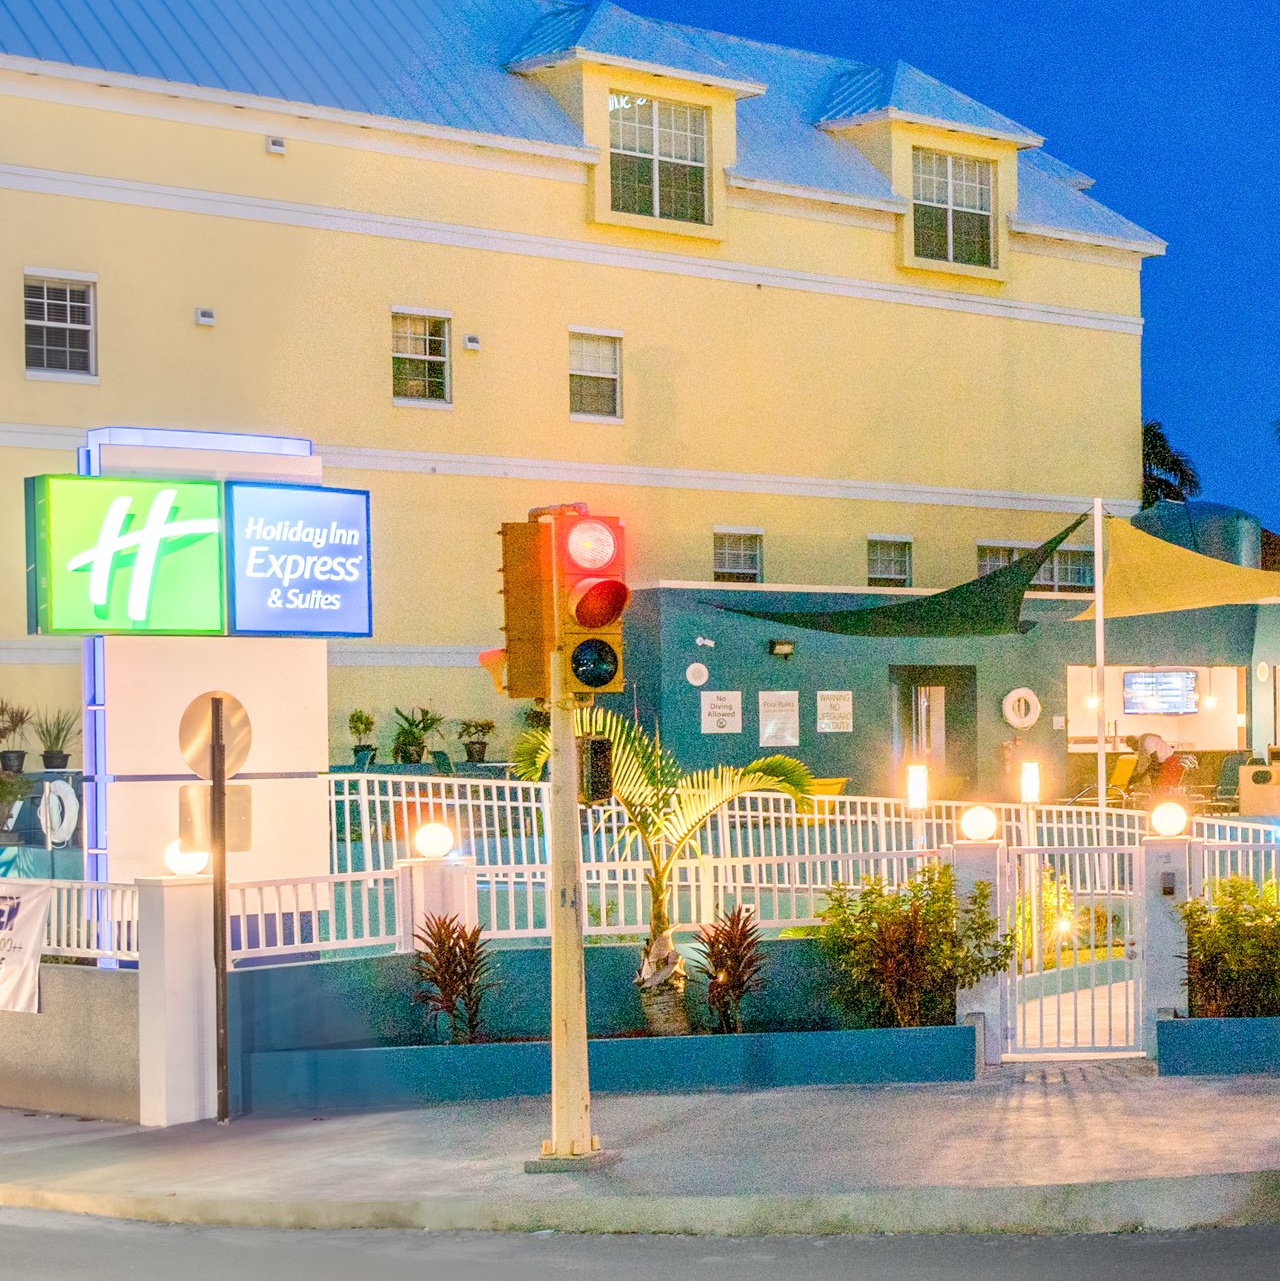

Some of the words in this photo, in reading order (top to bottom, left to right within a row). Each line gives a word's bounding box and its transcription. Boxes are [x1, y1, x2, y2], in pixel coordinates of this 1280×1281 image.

[244, 517, 328, 548] Holiday
[329, 521, 359, 546] Inn
[245, 546, 362, 586] Express
[267, 589, 282, 608] &
[286, 588, 341, 610] Suites
[820, 694, 850, 702] WARNING
[710, 703, 733, 711] Diving
[830, 703, 840, 711] NO
[832, 721, 849, 730] DUTY
